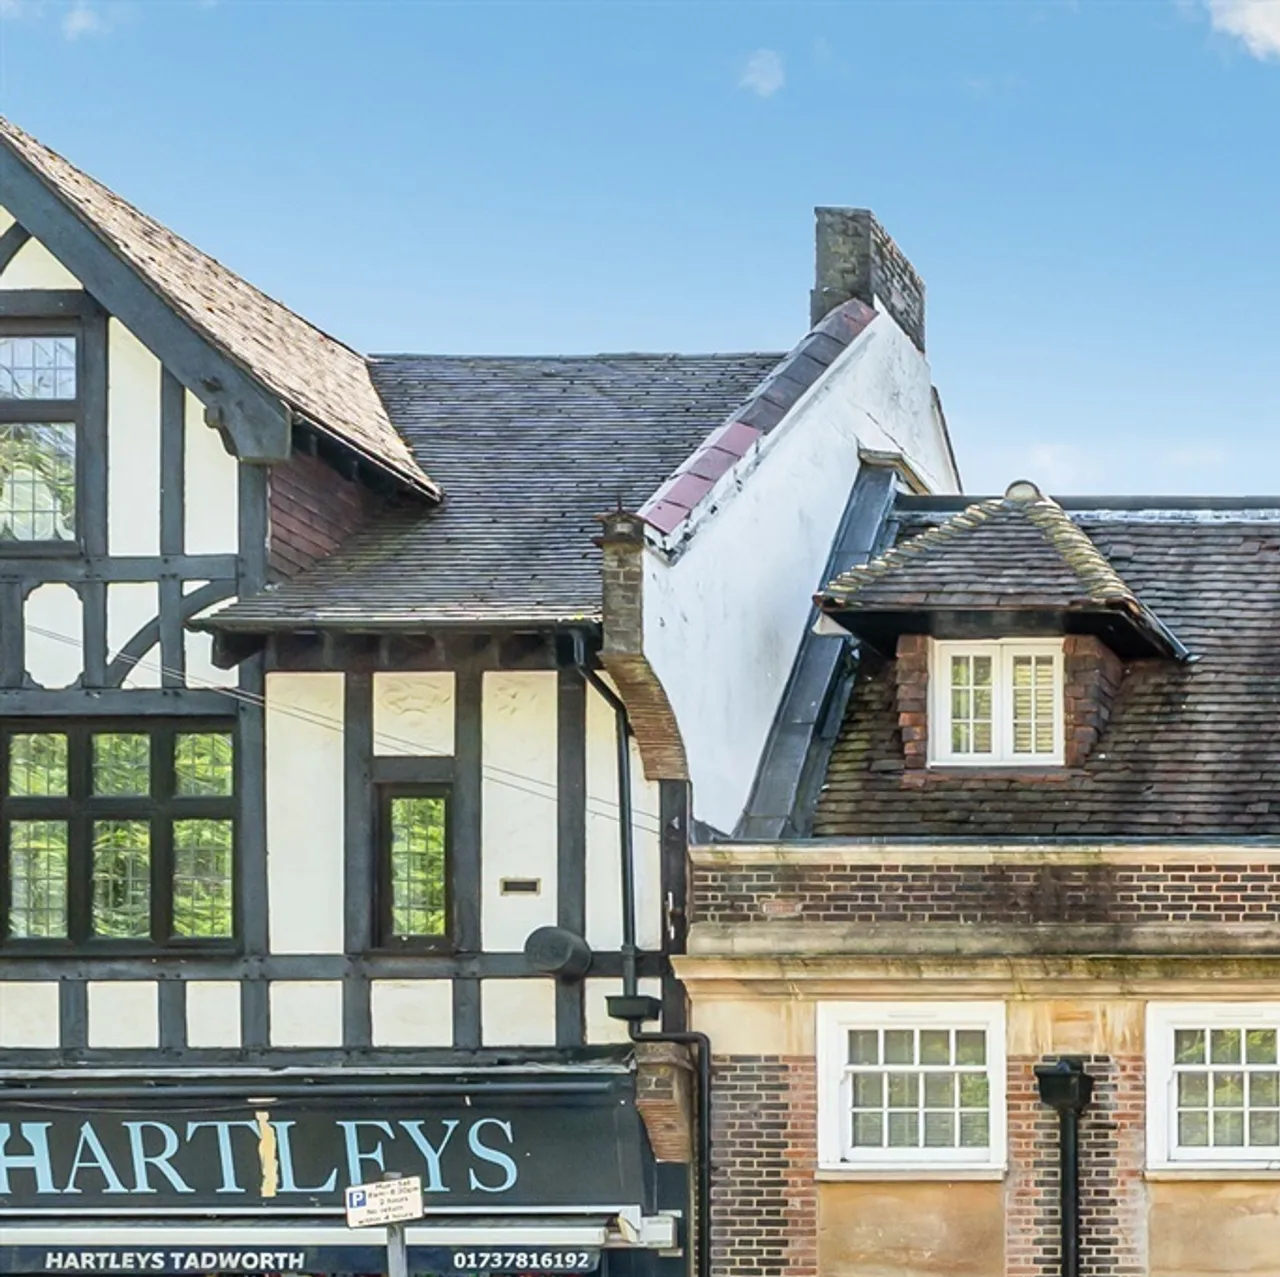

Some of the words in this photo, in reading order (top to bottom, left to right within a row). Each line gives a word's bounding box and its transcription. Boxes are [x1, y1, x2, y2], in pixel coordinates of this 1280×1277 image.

[45, 1252, 165, 1270] HARTLEYS
[170, 1252, 305, 1270] TADWORTH
[453, 1252, 589, 1269] 01737816192
